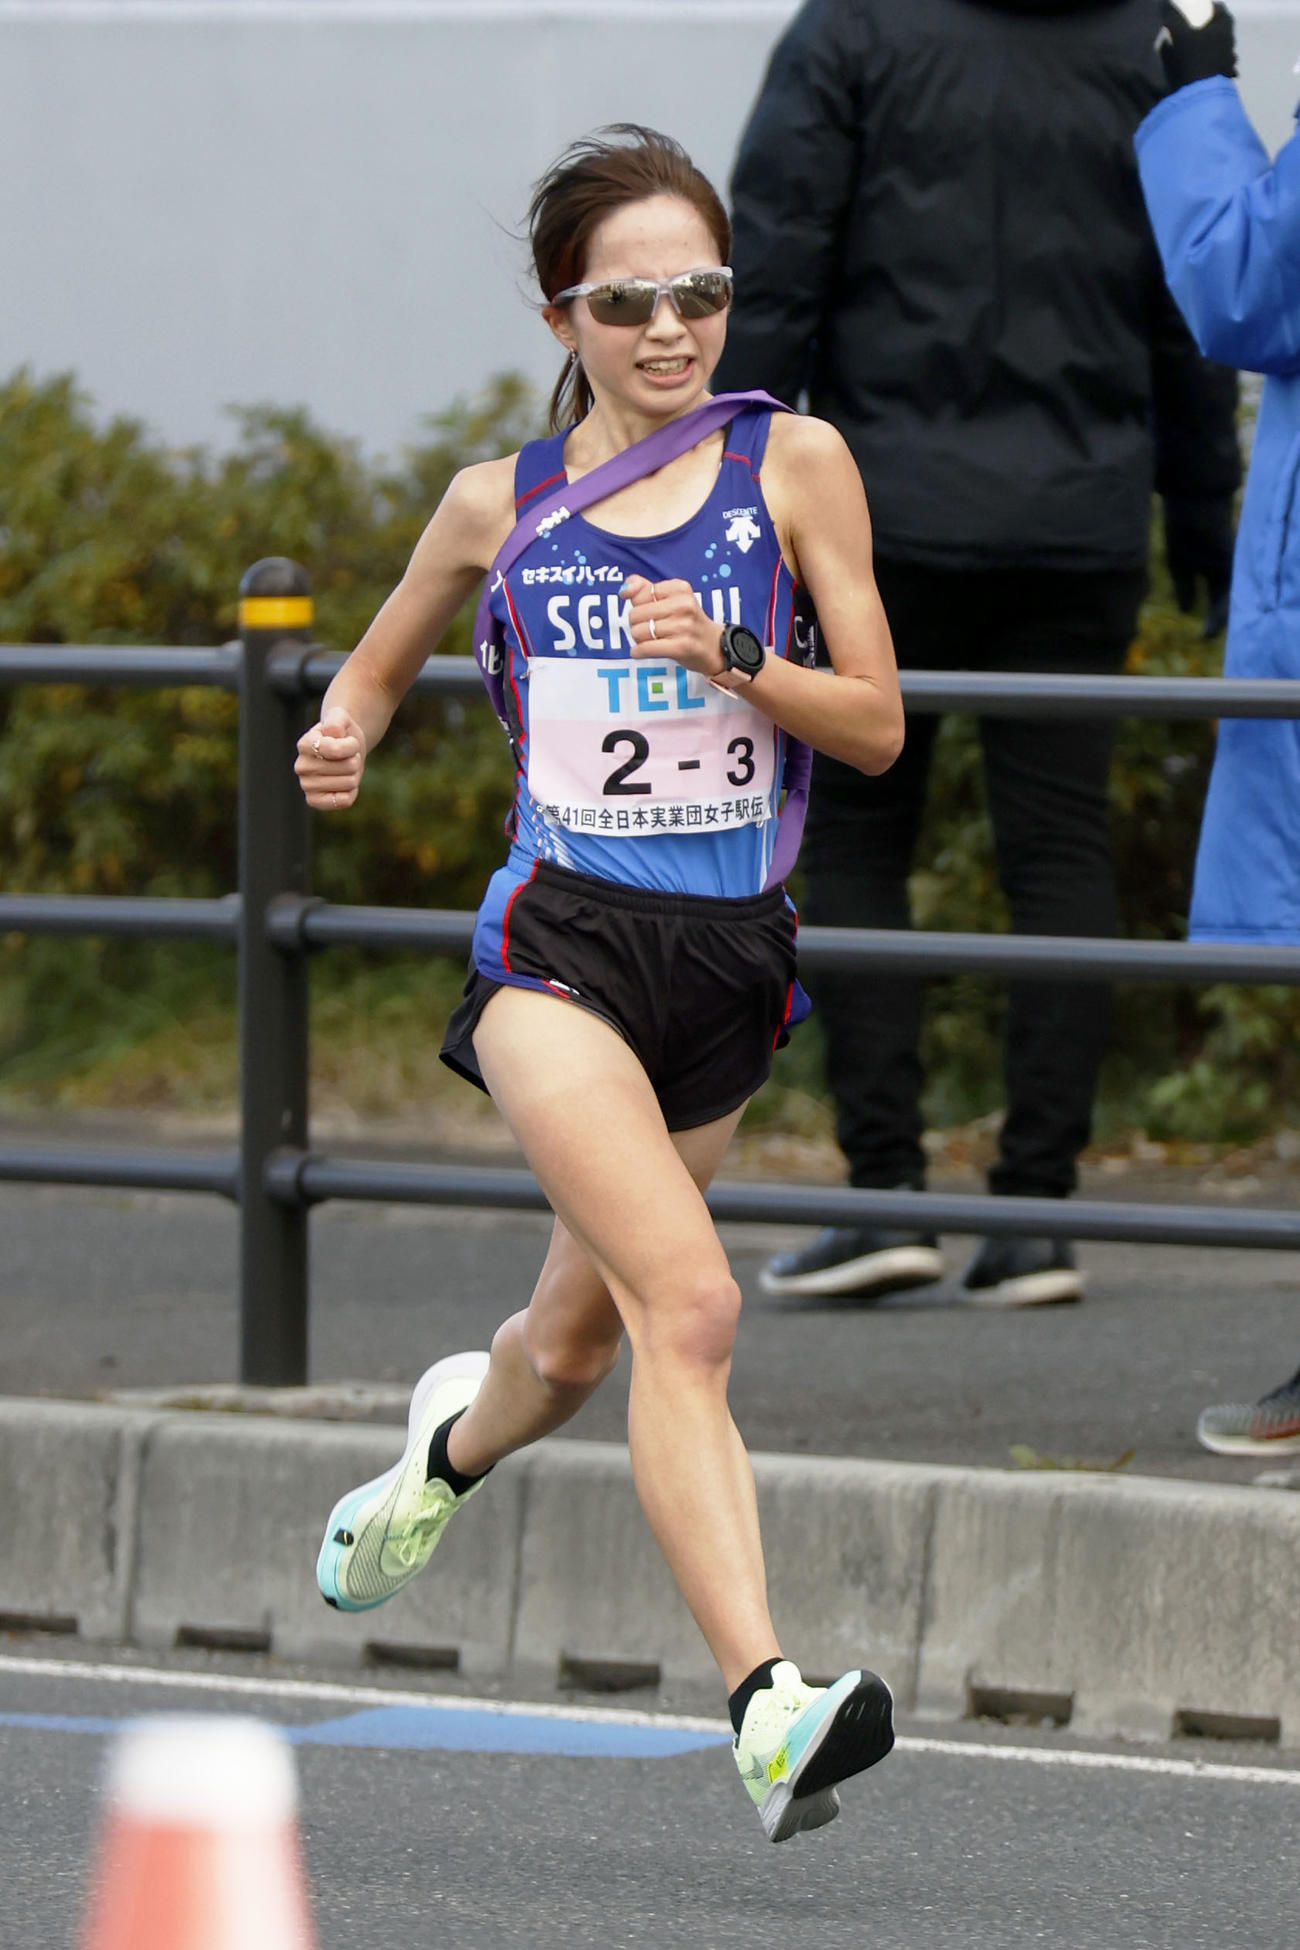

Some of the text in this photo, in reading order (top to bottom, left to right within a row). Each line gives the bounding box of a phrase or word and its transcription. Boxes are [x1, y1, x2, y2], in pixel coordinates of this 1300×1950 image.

[722, 506, 758, 519] DESCENTE
[521, 565, 624, 585] セキスイハイム
[597, 665, 706, 713] TEL
[546, 796, 764, 830] 第41回全日本実業団女子駅伝
